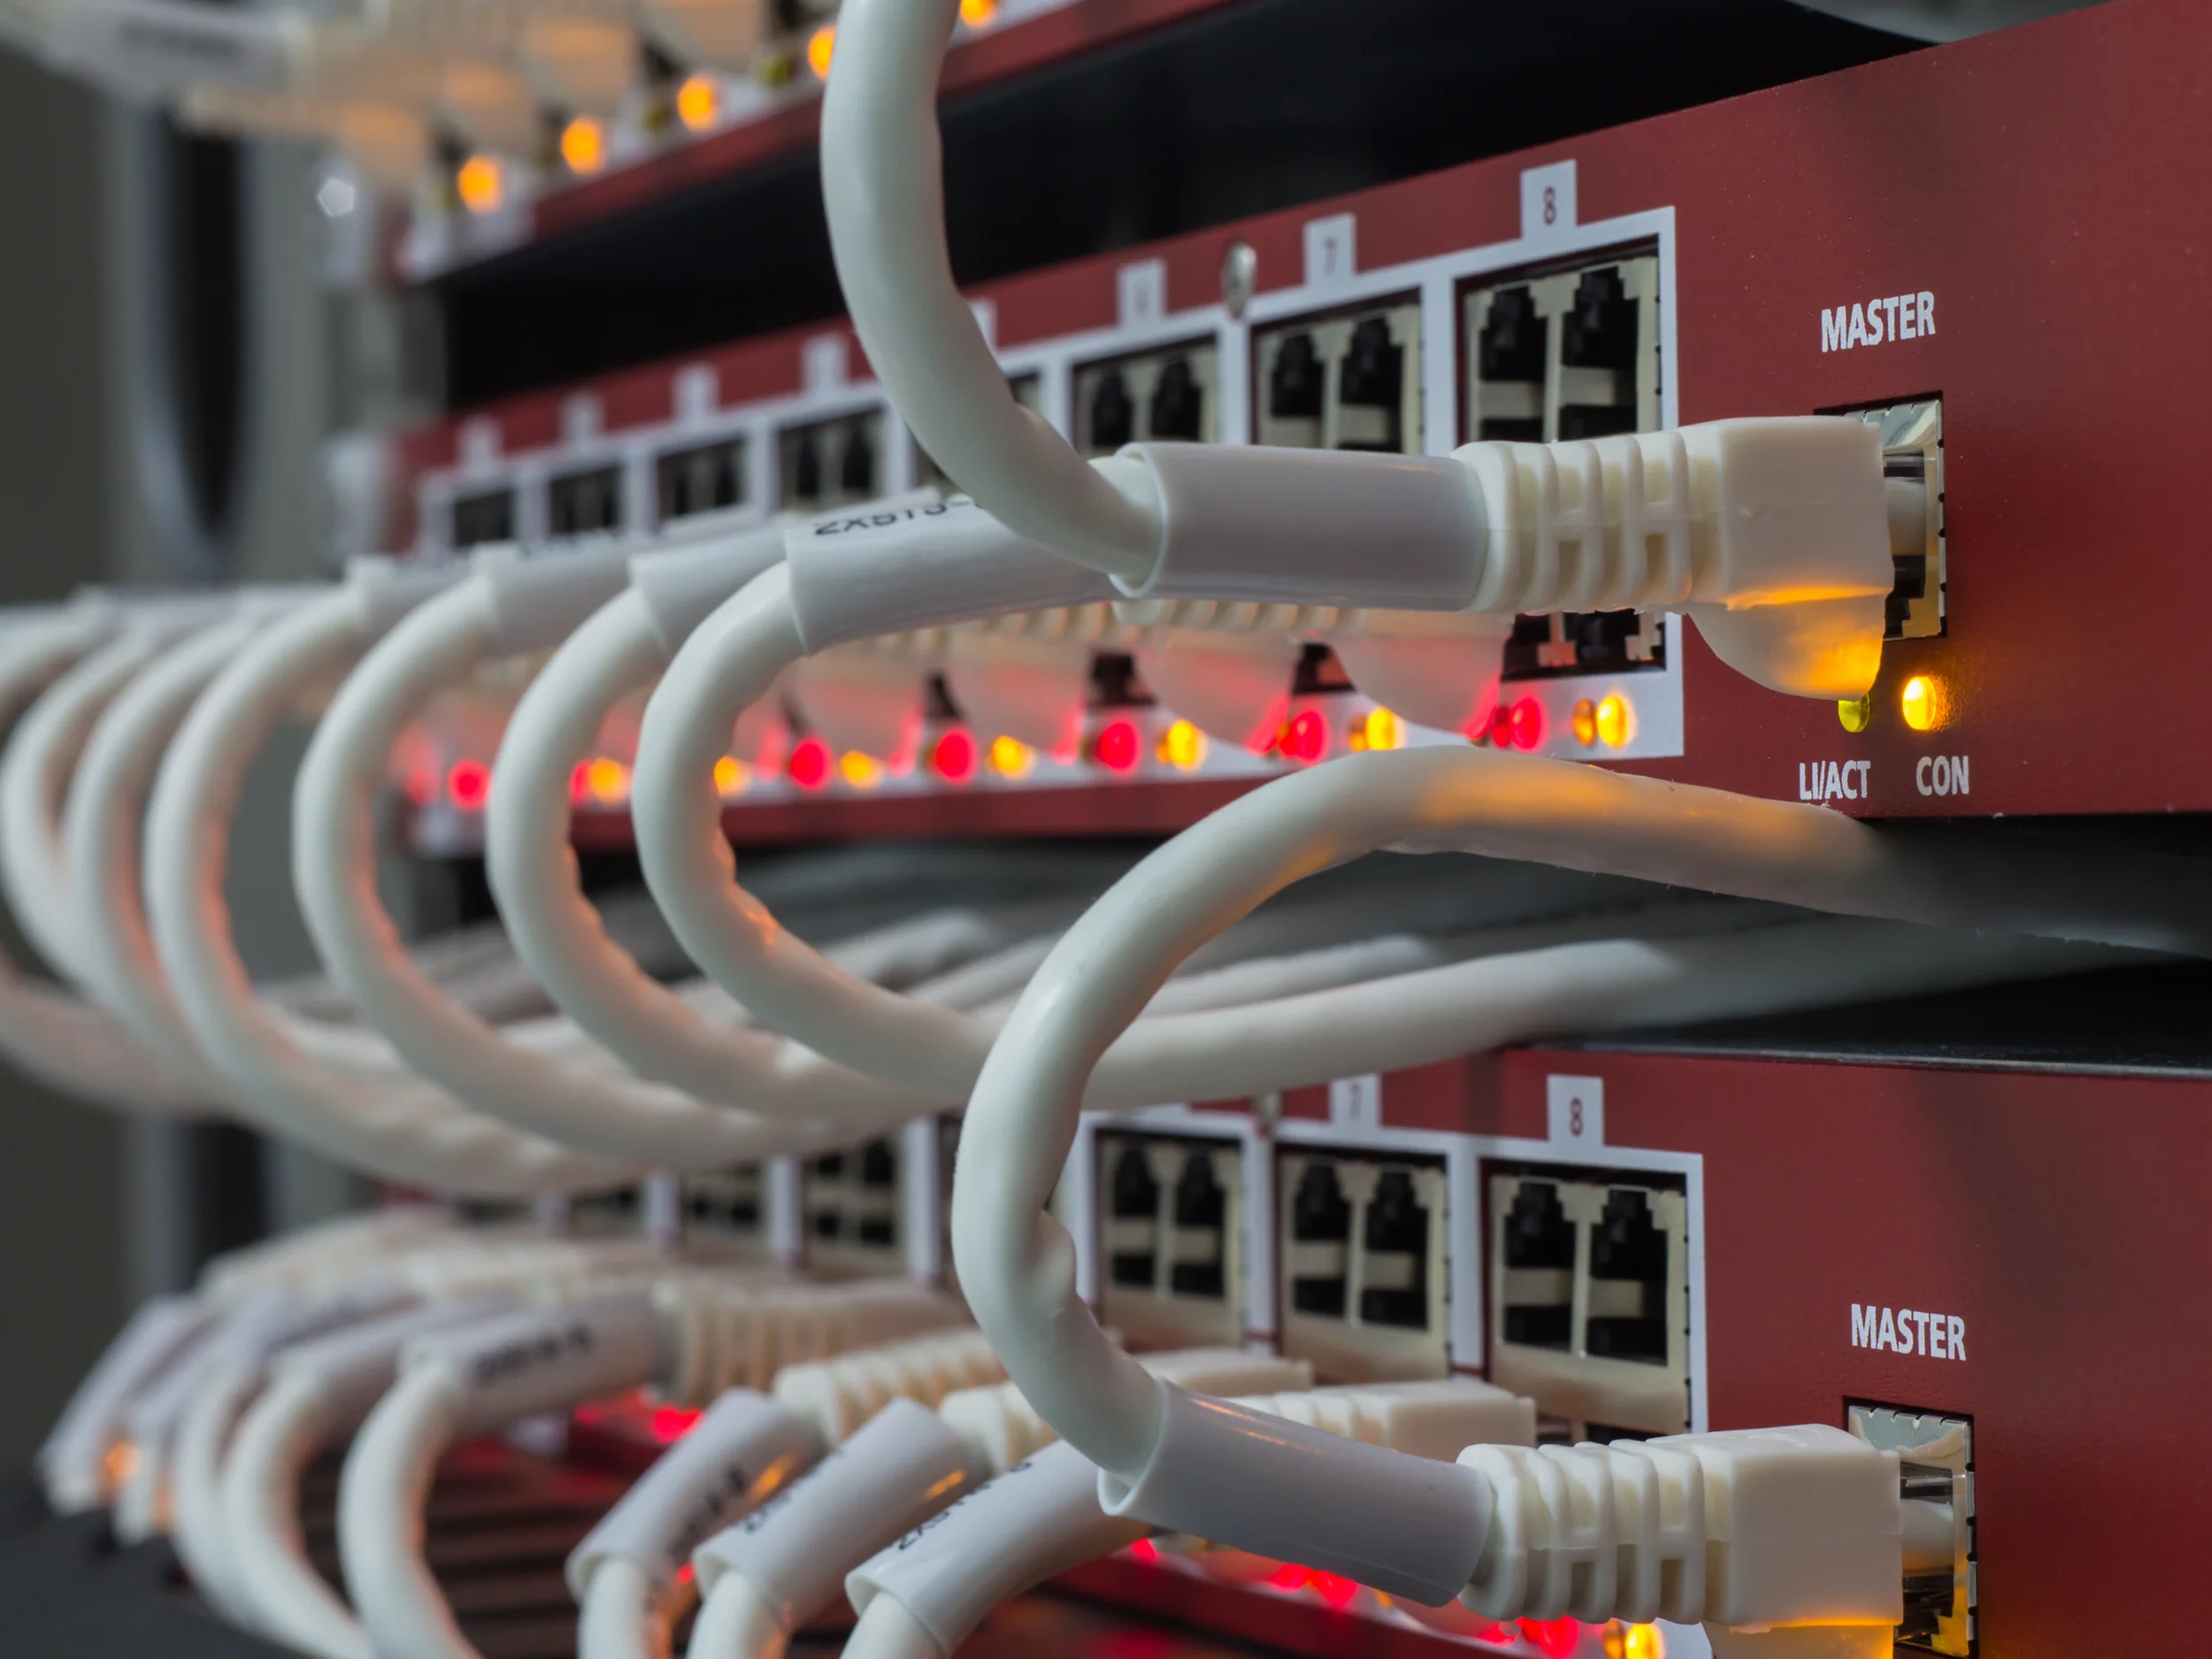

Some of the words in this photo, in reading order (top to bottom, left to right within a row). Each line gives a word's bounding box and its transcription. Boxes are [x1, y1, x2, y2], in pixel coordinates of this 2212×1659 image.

[1542, 185, 1557, 227] 8
[1821, 290, 1936, 353] MASTER
[1799, 759, 1871, 800] LI/ACT
[1916, 755, 1970, 796] CON
[1569, 1096, 1585, 1138] 8
[1851, 1302, 1966, 1362] MASTER
